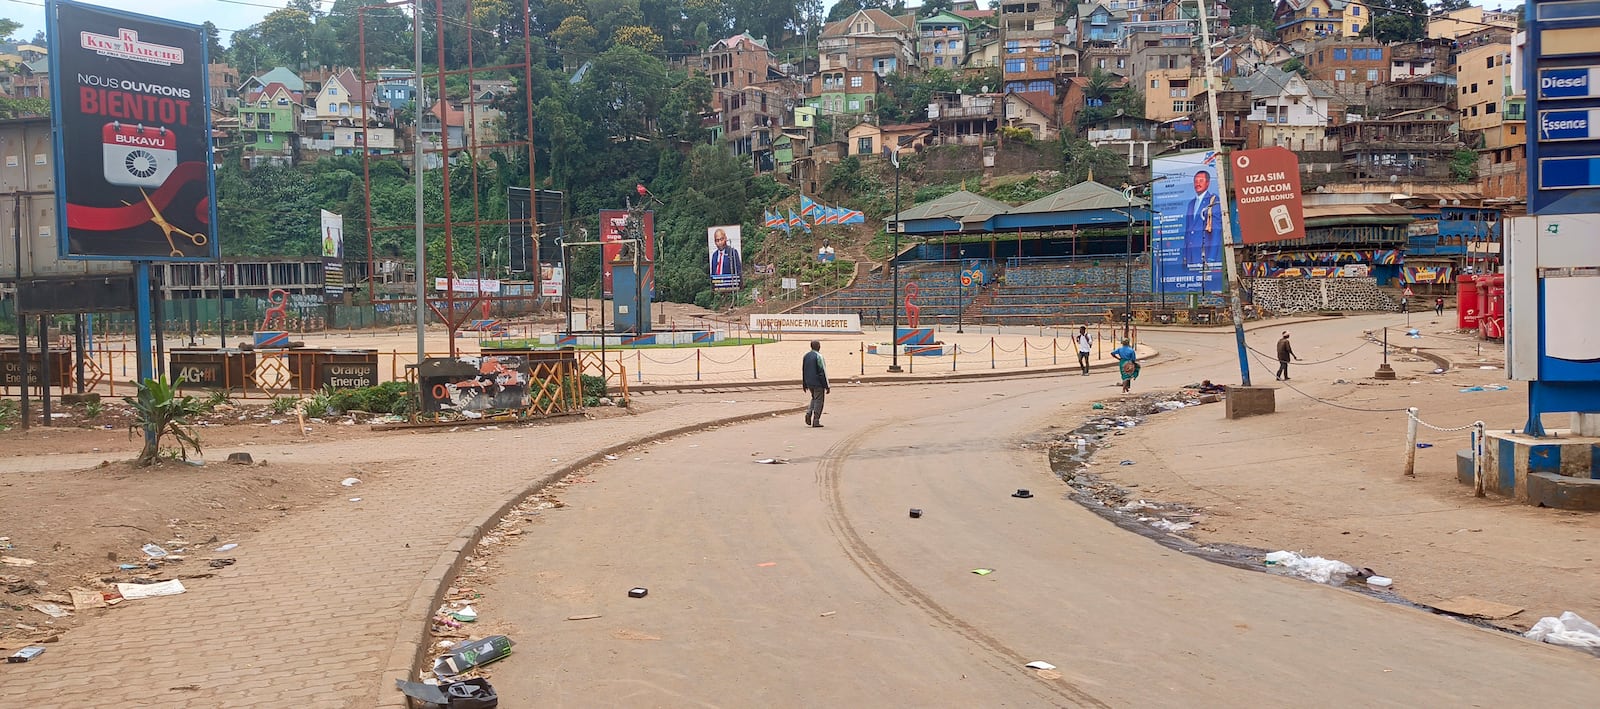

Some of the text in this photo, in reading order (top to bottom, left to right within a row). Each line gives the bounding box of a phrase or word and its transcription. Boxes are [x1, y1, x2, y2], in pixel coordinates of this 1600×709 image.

[123, 32, 133, 41] K
[87, 35, 112, 49] KIN
[124, 42, 180, 60] MARCHE
[77, 72, 191, 99] NOUS OUVRONS
[1541, 75, 1586, 88] Diesel
[79, 86, 190, 126] BIENTOT
[1543, 119, 1586, 130] Essence
[115, 134, 165, 147] BUKAVU
[1246, 171, 1285, 183] UZA SIM
[1242, 183, 1291, 195] VODACOM
[1241, 192, 1295, 204] QUADRA BONUS
[6, 362, 38, 374] Orage
[331, 365, 371, 377] Orange
[5, 373, 37, 384] Eneie
[330, 376, 370, 388] Energie
